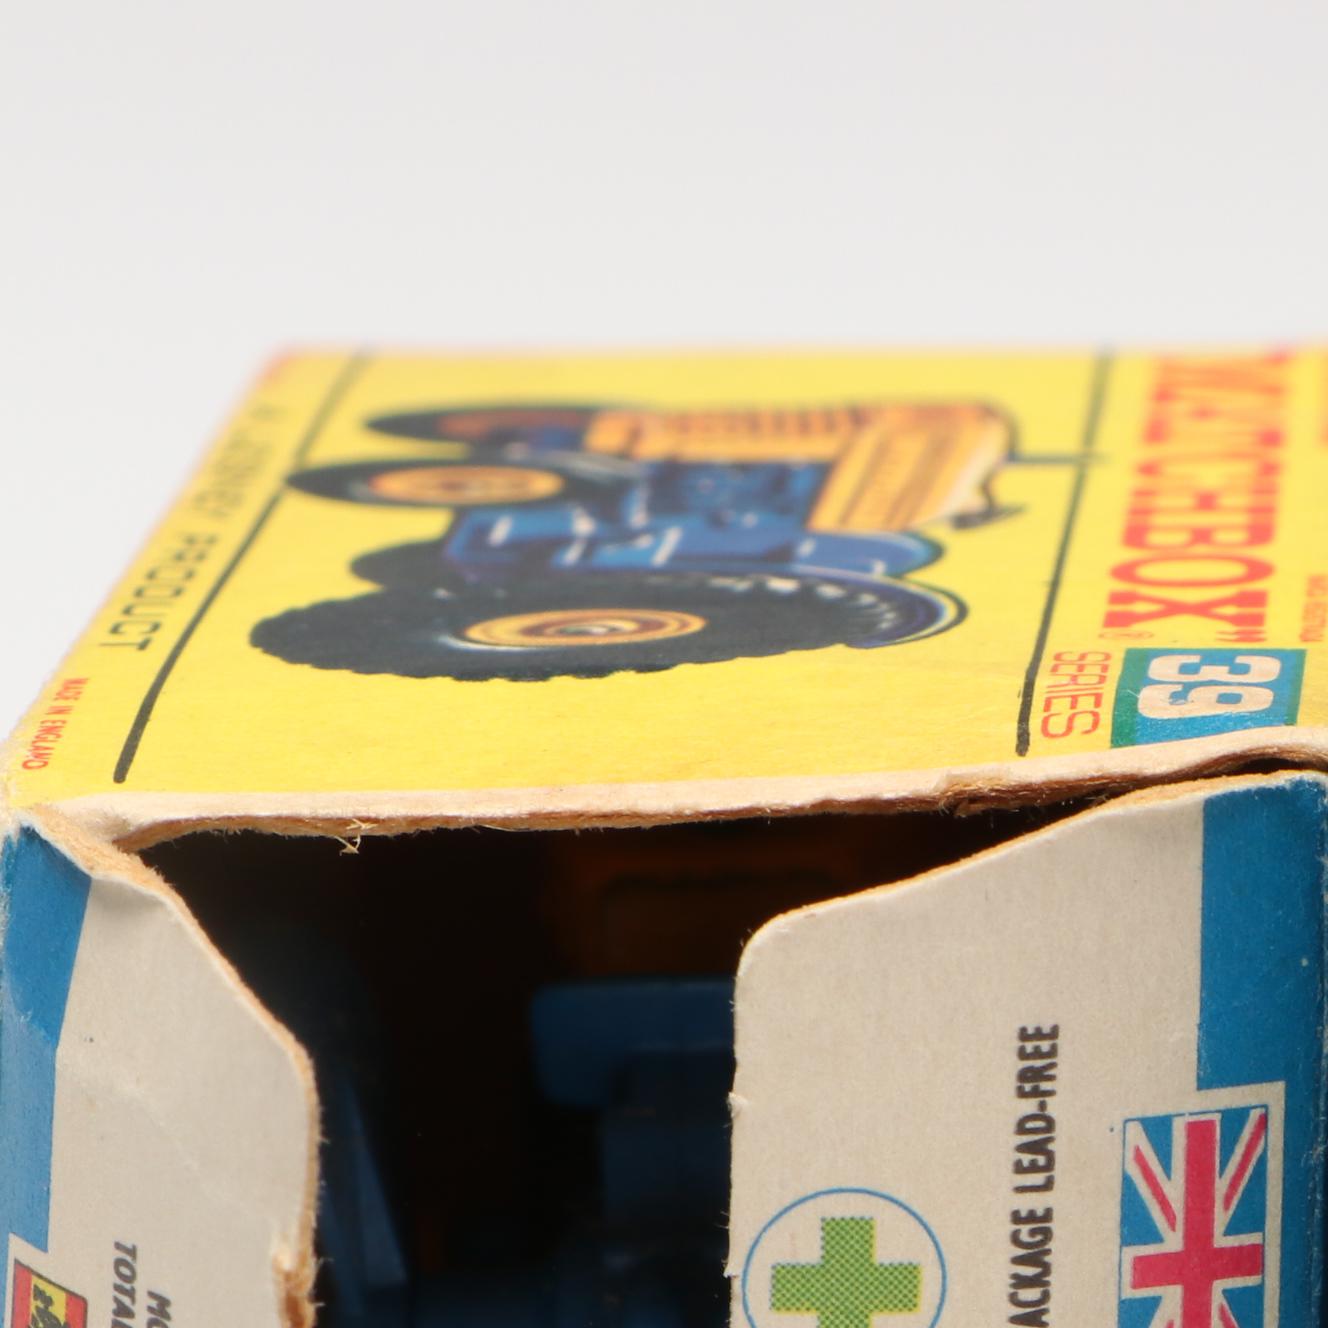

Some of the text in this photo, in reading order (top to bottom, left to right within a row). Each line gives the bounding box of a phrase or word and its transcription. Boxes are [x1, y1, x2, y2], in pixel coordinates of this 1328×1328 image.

[98, 531, 219, 650] PRODUCT
[22, 677, 91, 770] MADE IN ENGLAND
[1040, 650, 1112, 740] SERIES
[1137, 653, 1282, 721] 39
[1014, 1023, 1060, 1195] LEAD-FREE
